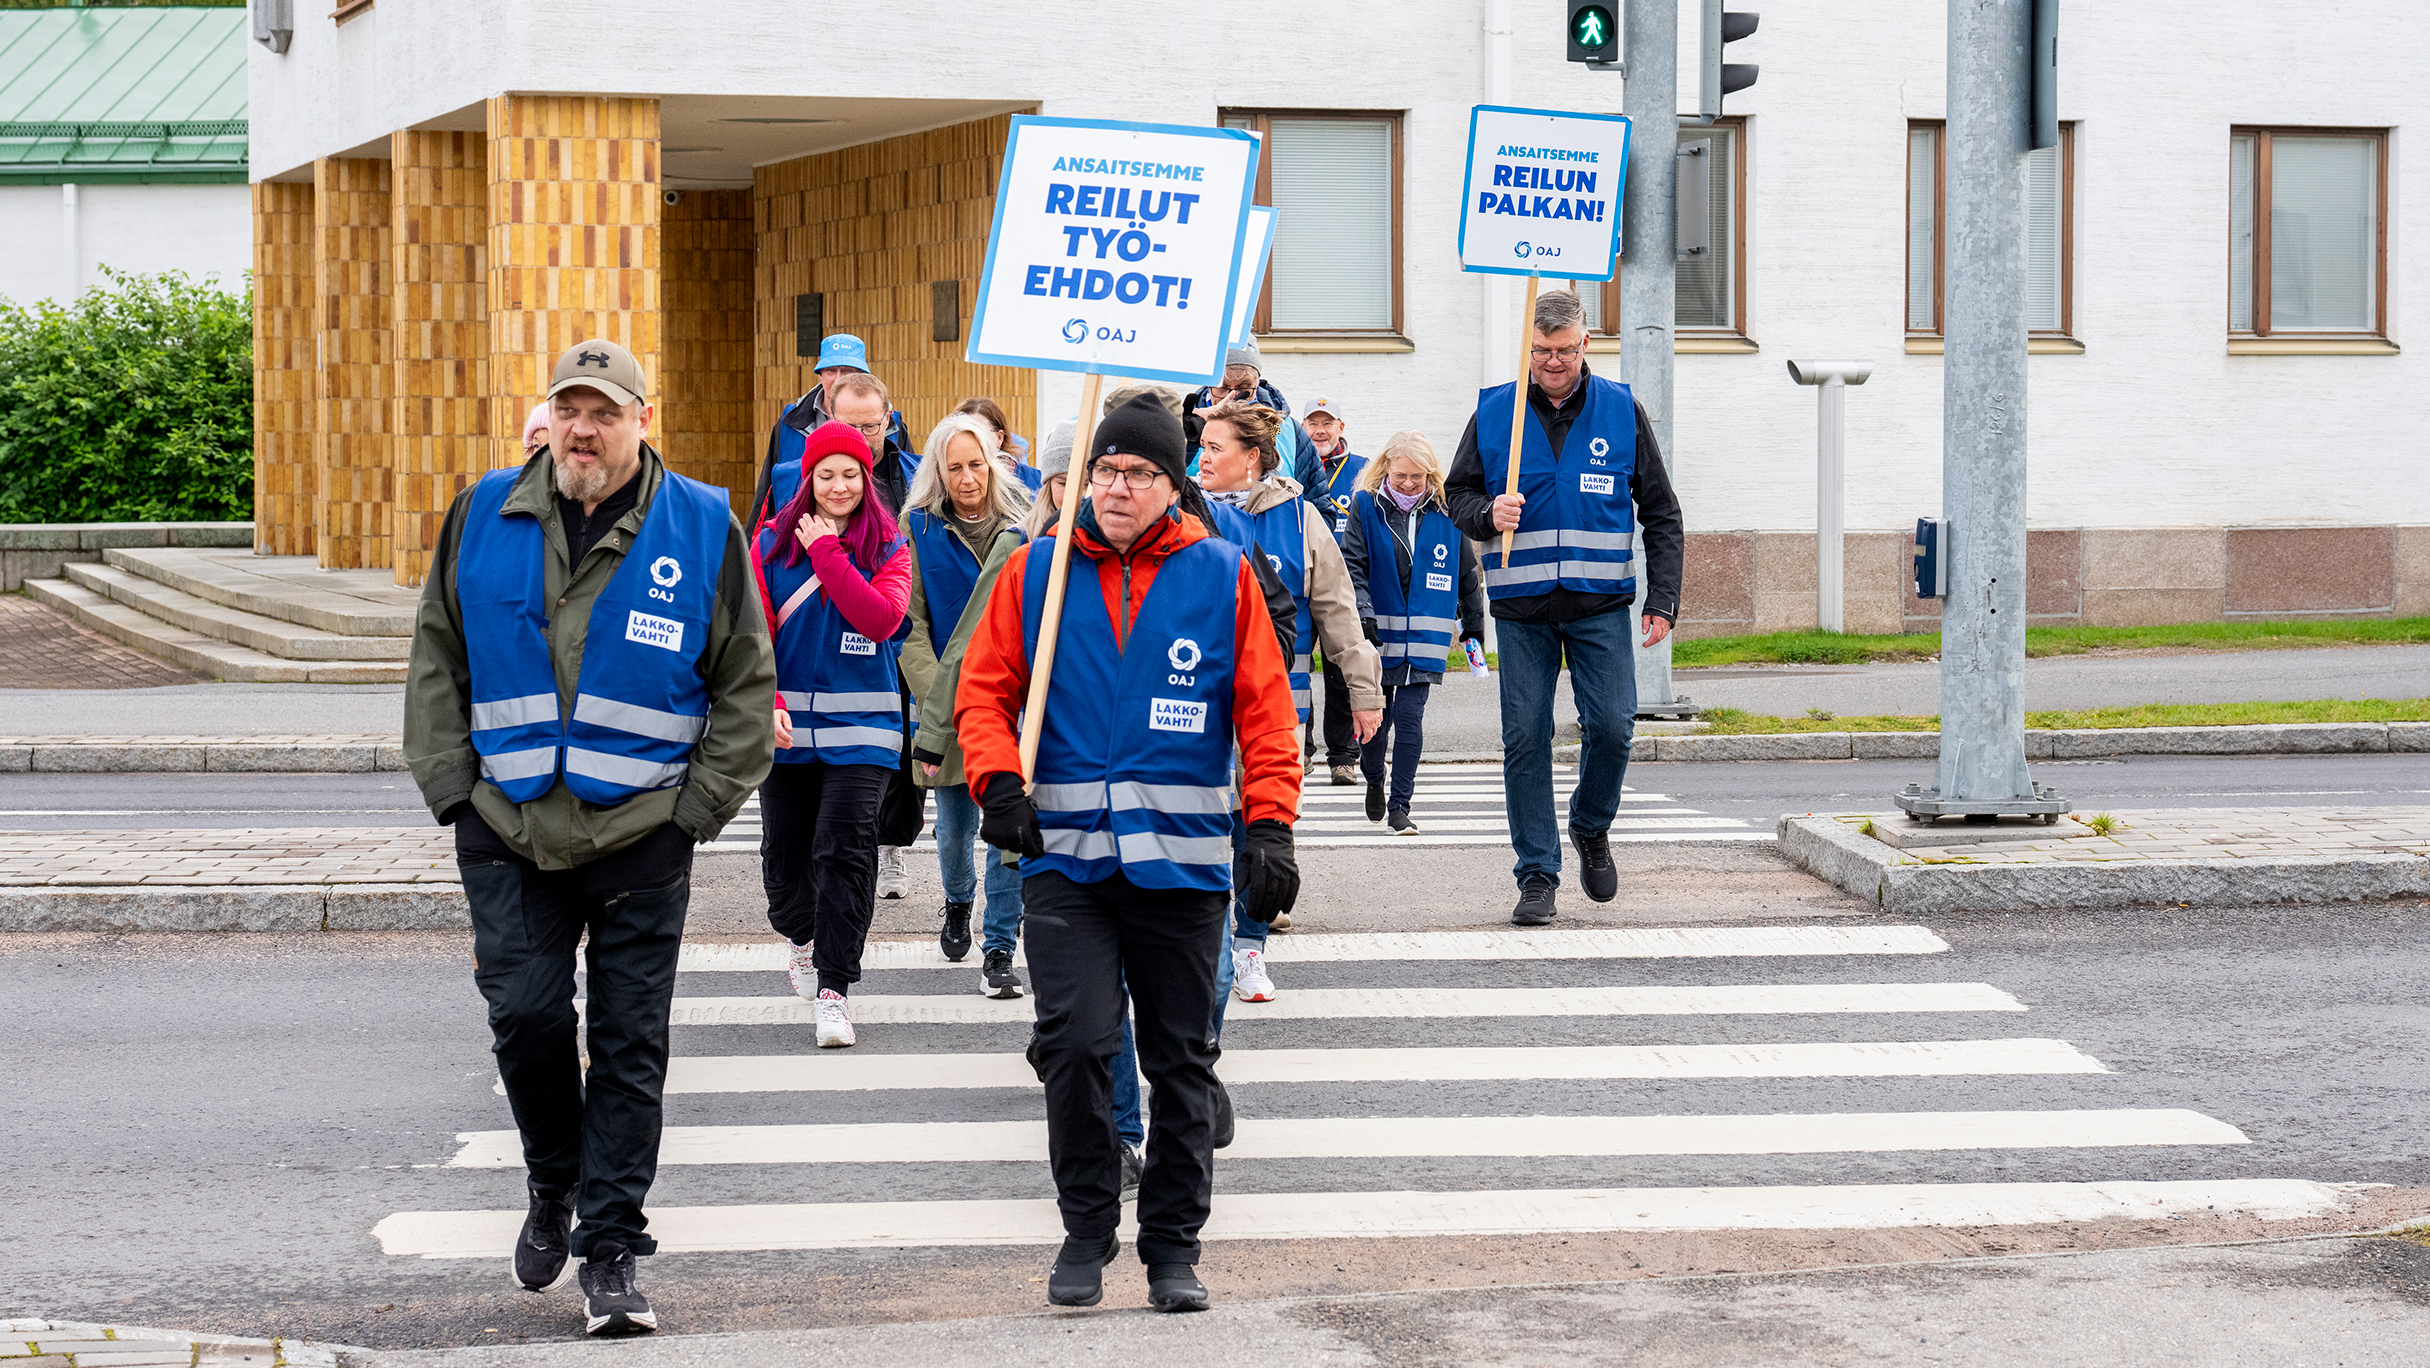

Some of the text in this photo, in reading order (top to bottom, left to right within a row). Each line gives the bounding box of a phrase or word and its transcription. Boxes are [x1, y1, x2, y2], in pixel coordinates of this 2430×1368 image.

[1496, 145, 1599, 163] ANSAITSEMME
[1052, 156, 1205, 182] ANSAITSEMME
[1493, 164, 1597, 193] REILUN
[1045, 183, 1200, 225] REILUT
[1478, 191, 1605, 223] PALKAN!
[1063, 221, 1167, 262] TYÖ-
[1536, 246, 1562, 257] OAJ
[1023, 264, 1193, 310] EHDOT!
[1096, 326, 1137, 344] OAJ
[1590, 458, 1606, 466] OAJ
[1583, 476, 1612, 485] LAKKO-
[1583, 483, 1606, 491] VAHTI
[648, 587, 675, 603] OAJ
[633, 616, 679, 634] LAKKO-
[632, 627, 669, 644] VAHTI
[845, 635, 872, 644] LAKKO
[845, 643, 869, 652] VAHTI
[1168, 674, 1195, 687] OAJ
[1156, 703, 1203, 716] LAKKO-
[1155, 715, 1193, 728] VAHTI
